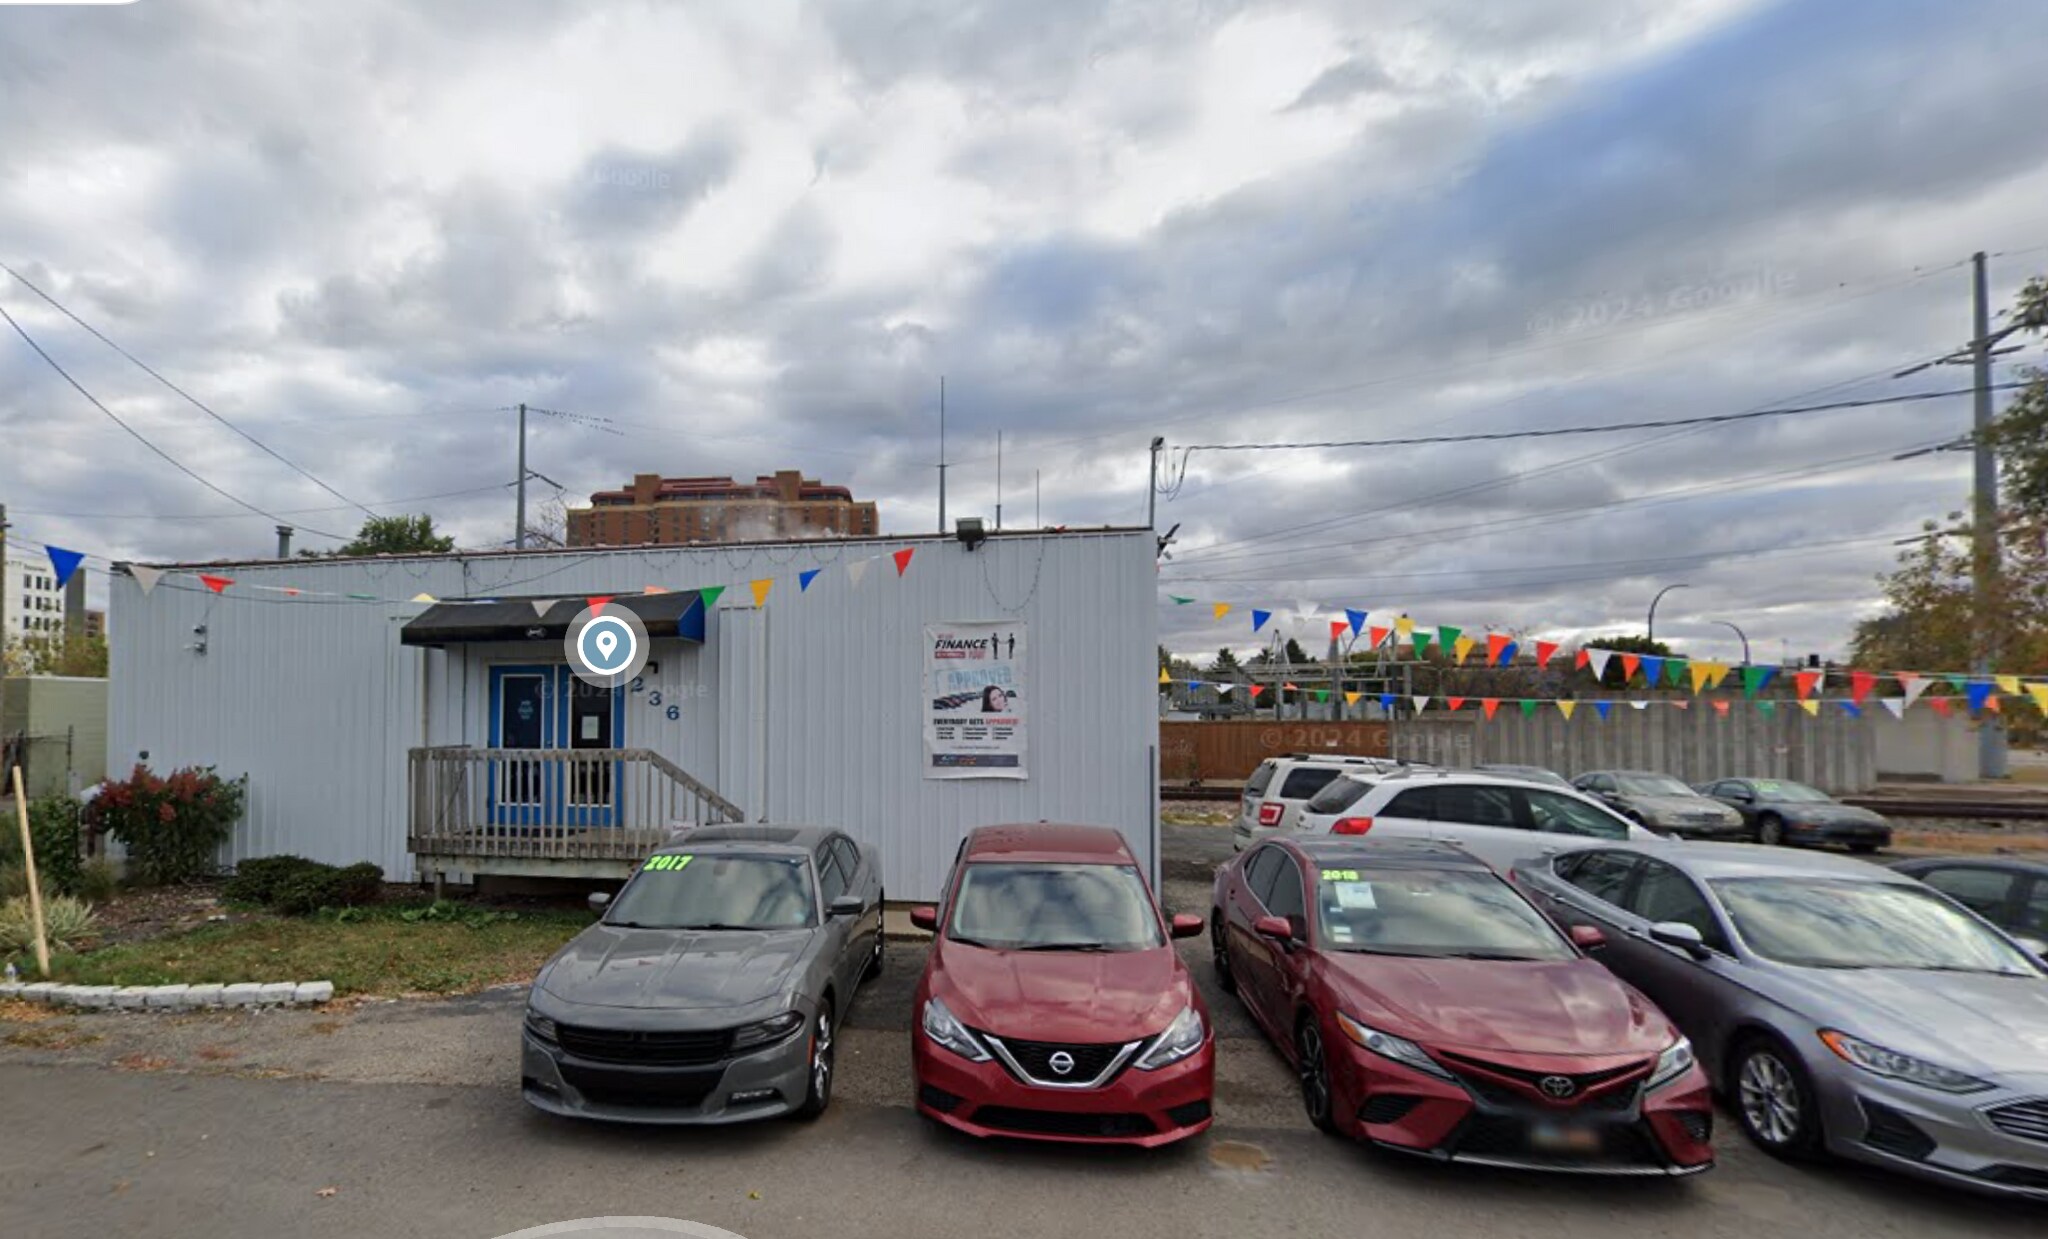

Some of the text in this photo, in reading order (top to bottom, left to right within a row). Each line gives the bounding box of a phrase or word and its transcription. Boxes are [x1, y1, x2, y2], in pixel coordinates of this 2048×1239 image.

[935, 639, 988, 649] FINANCE
[948, 665, 1012, 690] APPROVED
[643, 855, 693, 871] 2017
